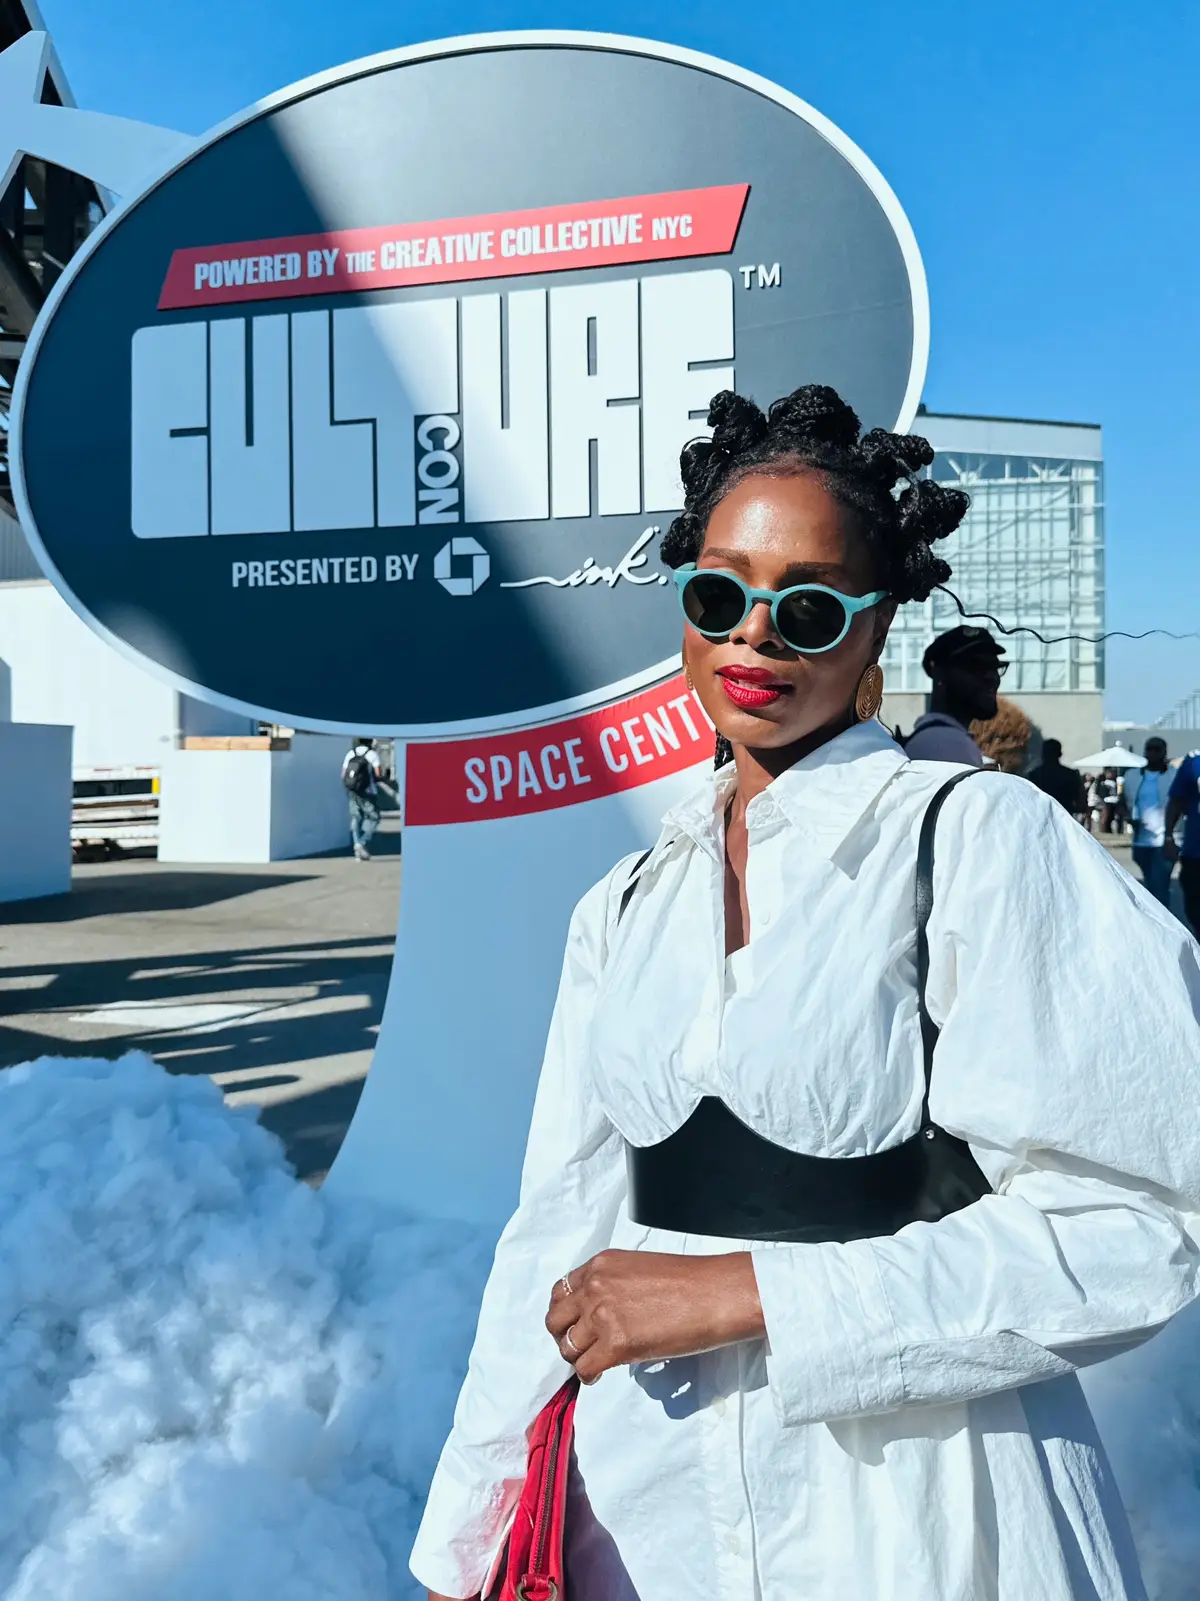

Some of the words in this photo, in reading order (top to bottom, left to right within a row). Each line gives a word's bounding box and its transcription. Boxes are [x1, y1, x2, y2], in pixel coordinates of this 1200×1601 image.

[193, 255, 301, 290] POWERED
[308, 248, 340, 277] BY
[345, 250, 376, 274] THE
[380, 230, 494, 271] CREATIVE
[499, 213, 642, 257] COLLECTIVE
[651, 213, 693, 241] NYC
[130, 269, 735, 539] CULTURE
[739, 262, 781, 289] TM
[417, 414, 460, 524] CON
[232, 557, 378, 588] PRESENTED
[385, 554, 419, 581] BY
[464, 737, 591, 804] SPACE
